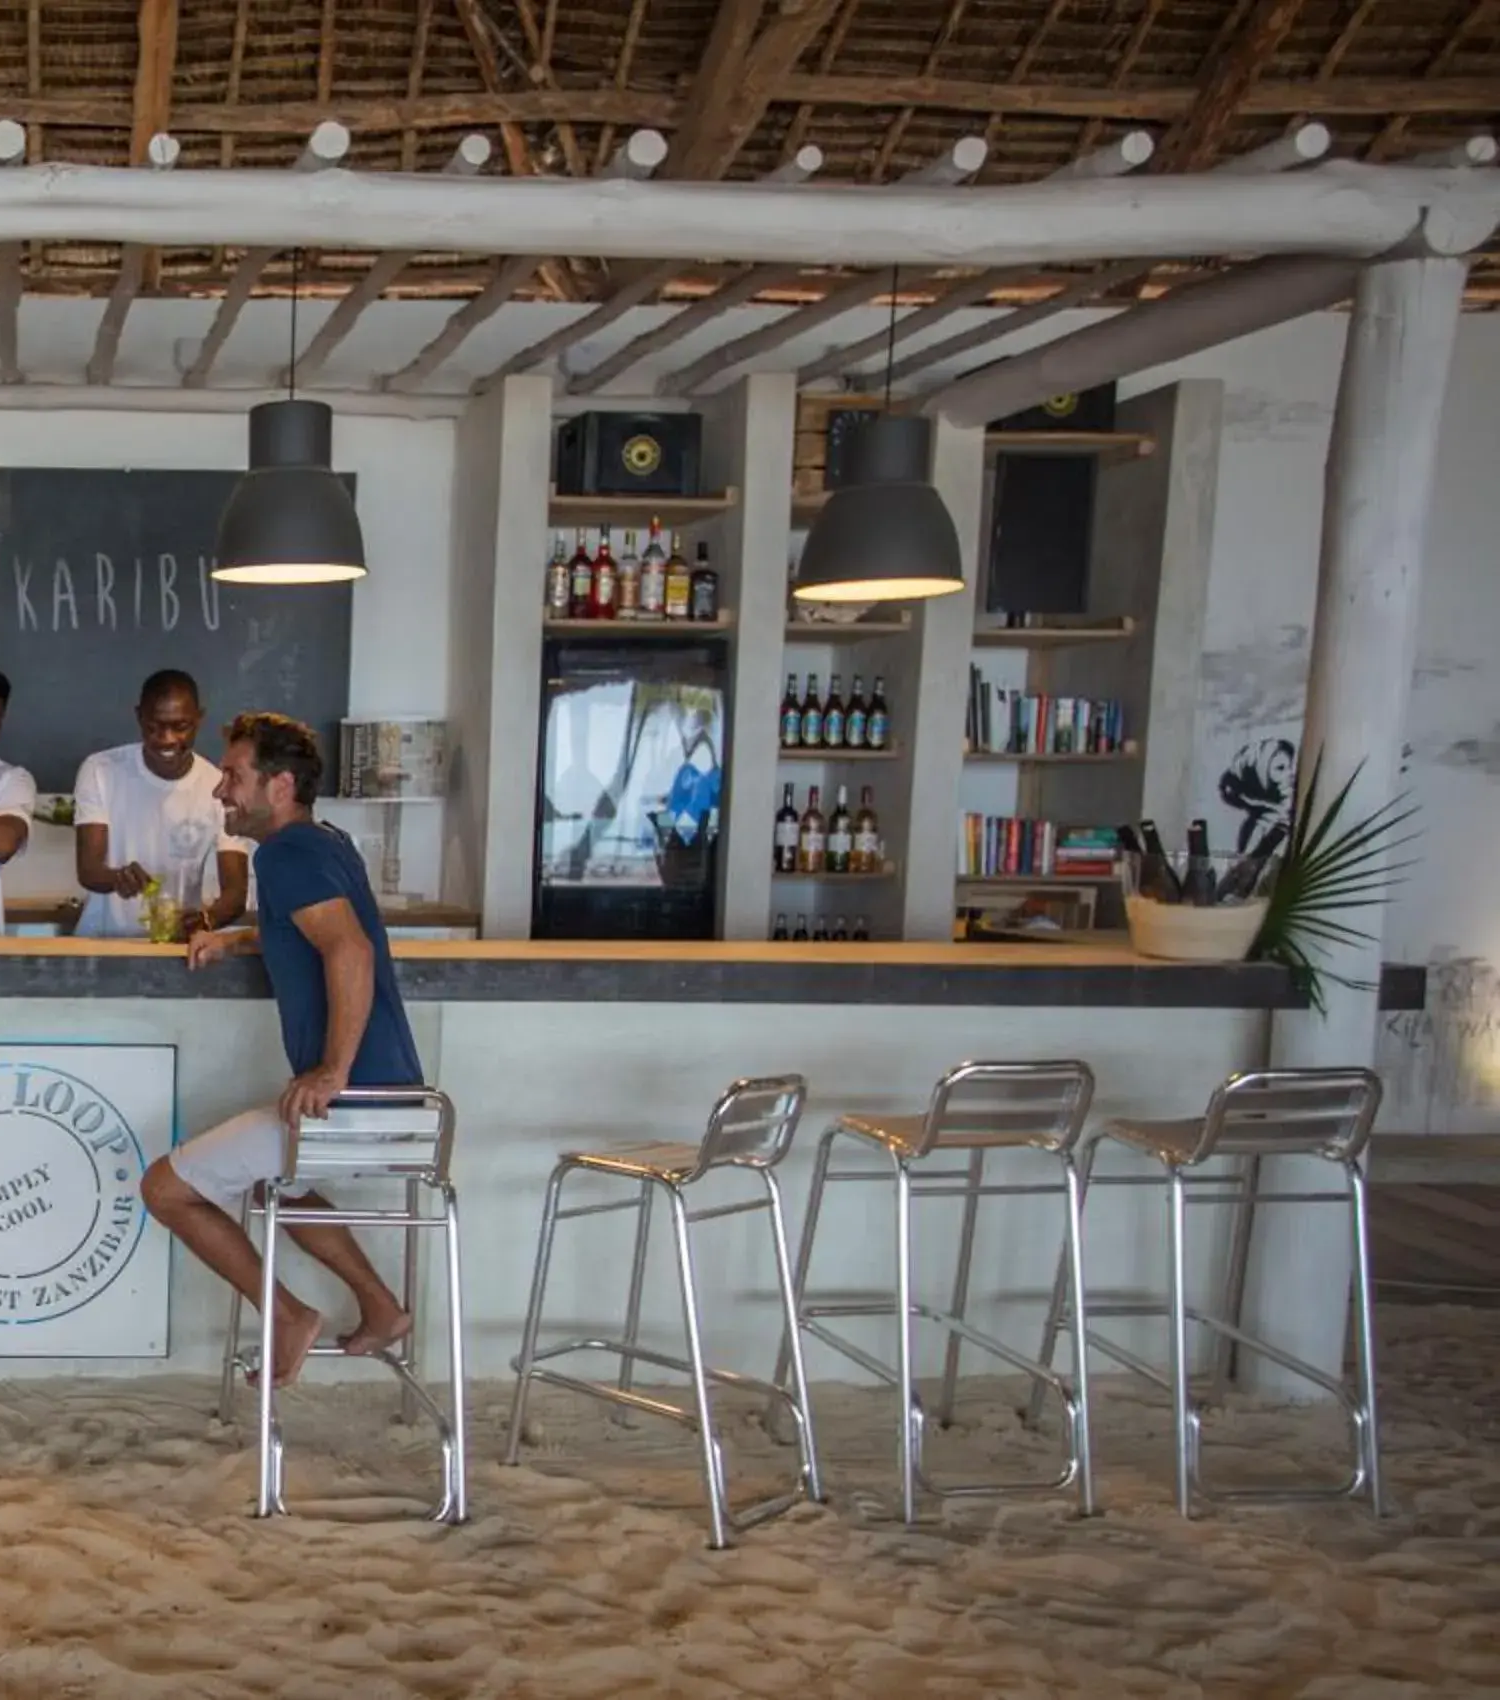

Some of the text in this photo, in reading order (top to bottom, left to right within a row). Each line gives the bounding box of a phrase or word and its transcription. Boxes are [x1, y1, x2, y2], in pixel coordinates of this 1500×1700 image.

[13, 552, 220, 631] KARIBU
[13, 1072, 129, 1155] LOOP
[32, 1195, 134, 1307] ZANZIBAR
